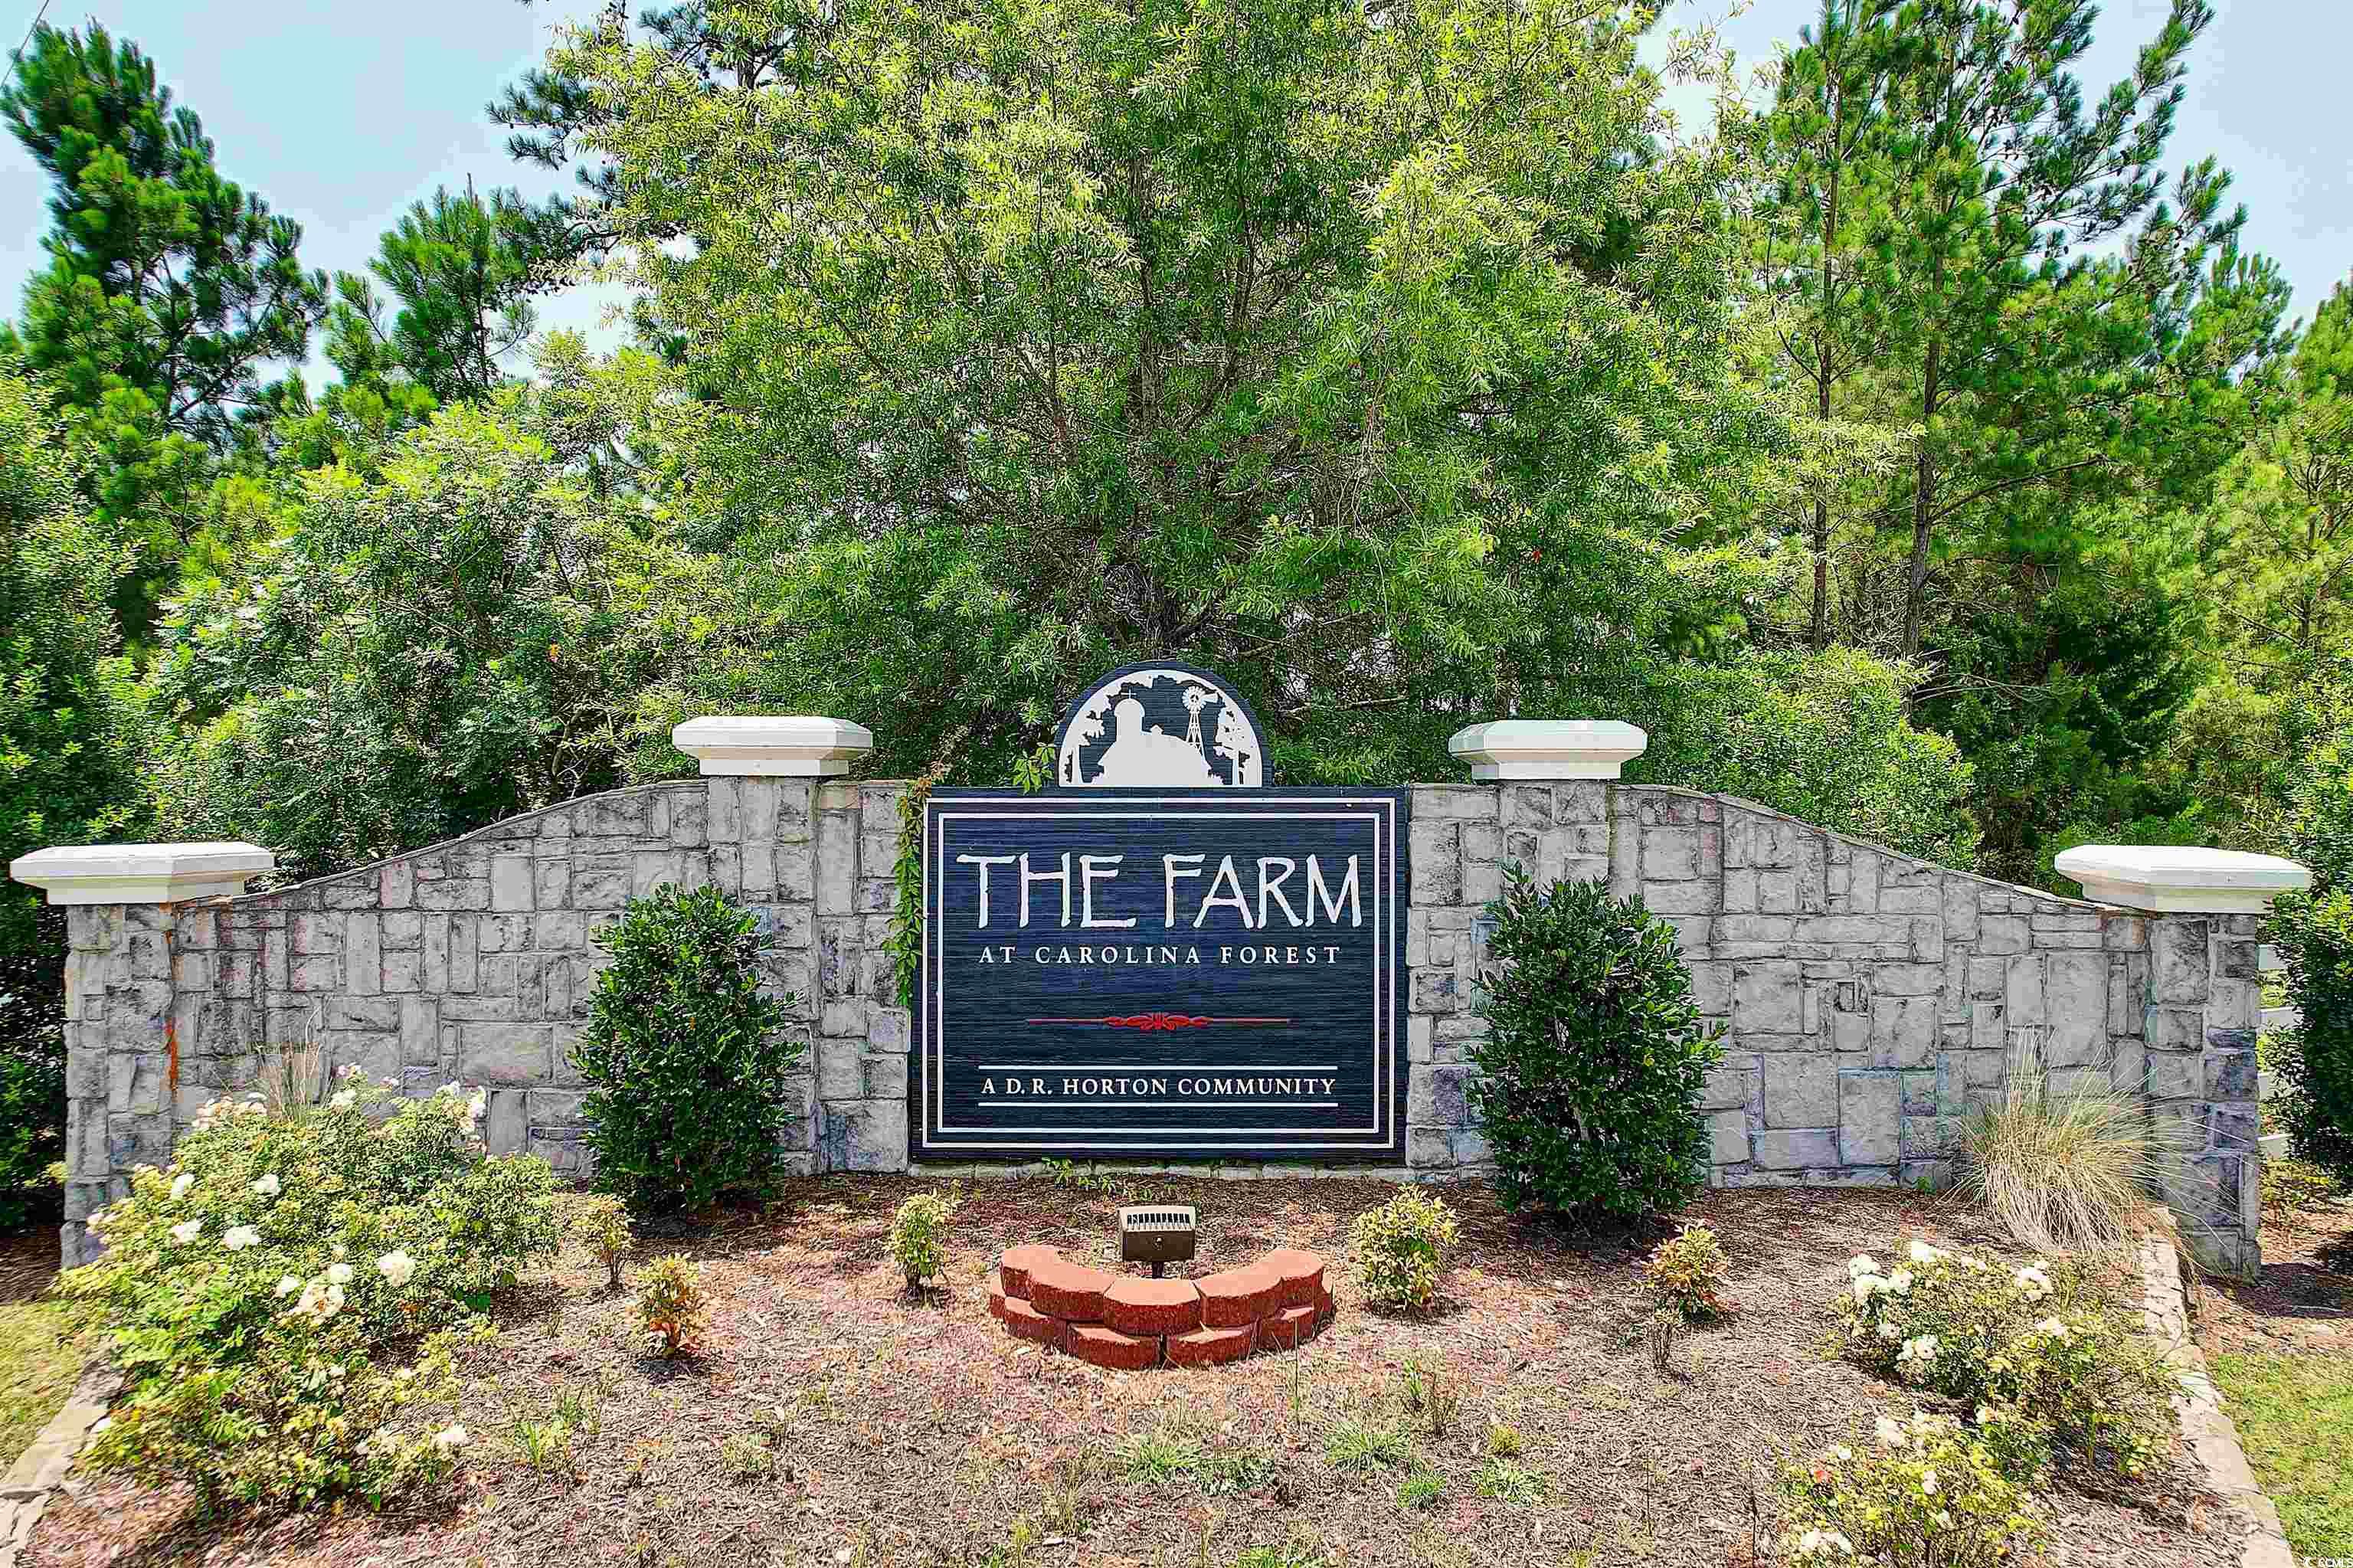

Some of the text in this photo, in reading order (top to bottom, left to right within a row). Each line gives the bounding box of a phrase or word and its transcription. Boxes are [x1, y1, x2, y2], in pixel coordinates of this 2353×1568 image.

[956, 852, 1363, 929] THE FARM
[979, 946, 1340, 964] AT CAROLINA FOREST
[981, 1078, 996, 1094] A
[1062, 1078, 1167, 1095] HORTON
[1178, 1078, 1336, 1095] COMMUNITY
